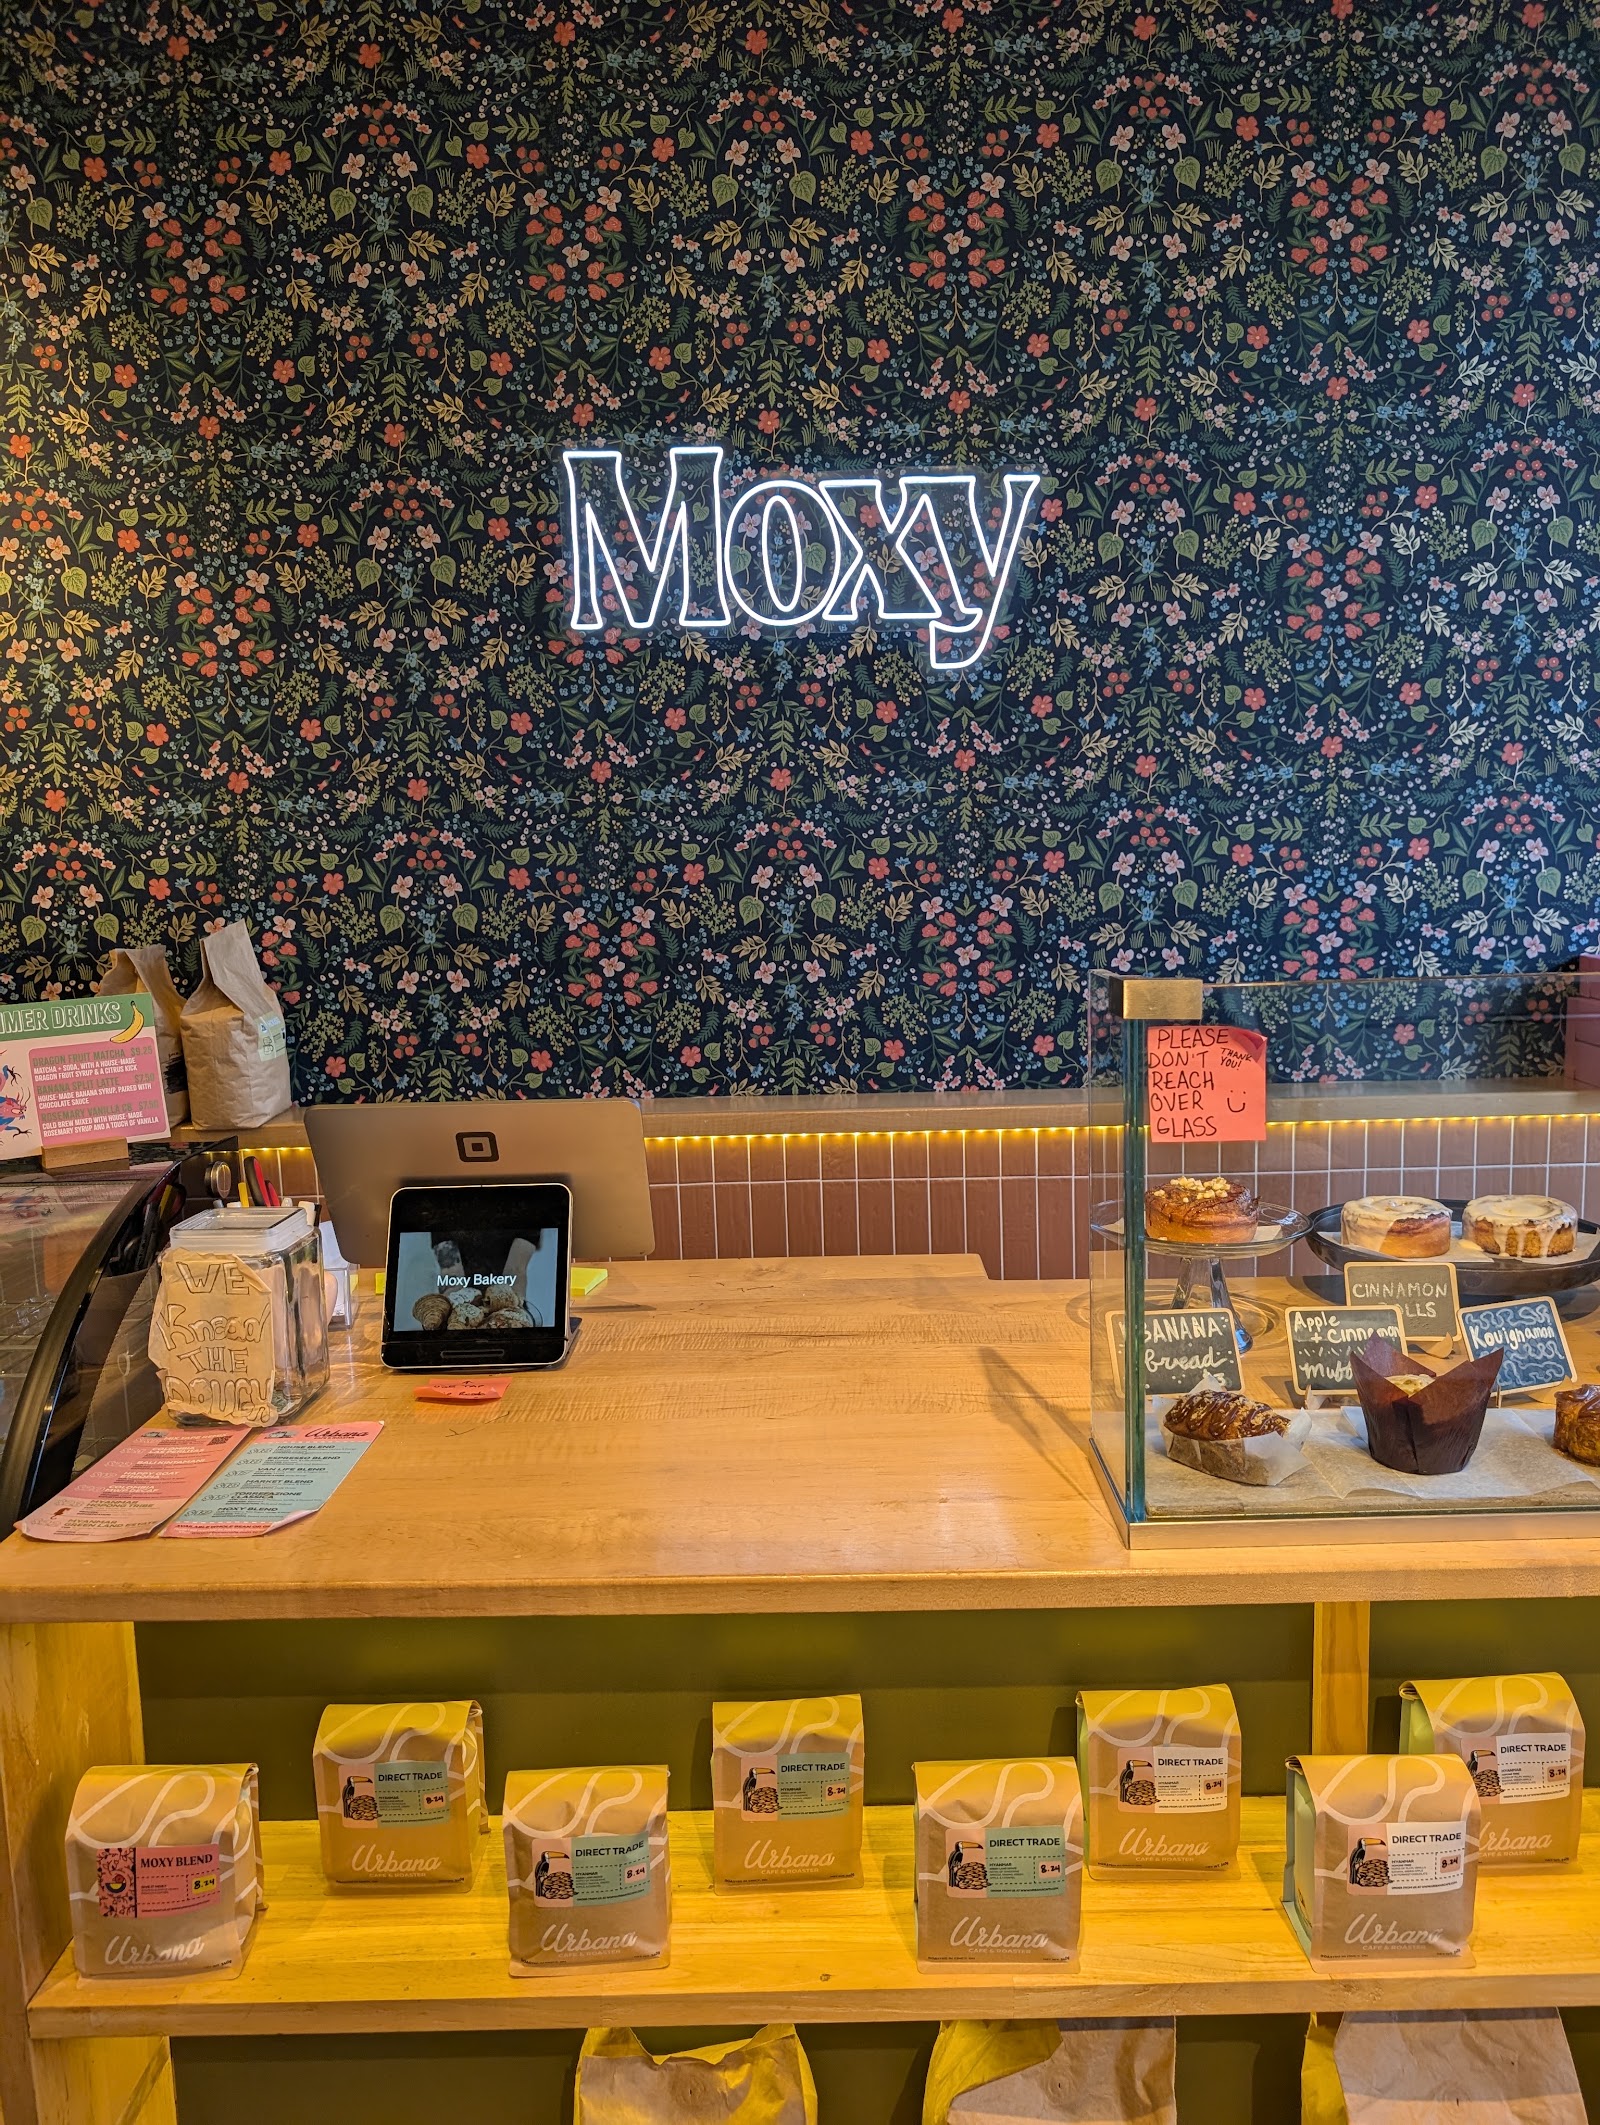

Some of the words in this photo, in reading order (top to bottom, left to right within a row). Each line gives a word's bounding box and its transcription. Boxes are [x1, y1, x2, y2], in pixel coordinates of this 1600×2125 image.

[562, 446, 1040, 670] Moxy
[51, 1001, 121, 1029] DRINKS
[1158, 1028, 1229, 1049] PLEASE
[33, 1056, 65, 1066] DRAGON
[68, 1053, 90, 1062] FRUIT
[94, 1049, 125, 1059] MATCHA
[1149, 1050, 1208, 1068] DON'T
[1221, 1048, 1252, 1061] THANK
[34, 1065, 57, 1075] MATCHA
[81, 1061, 94, 1070] WITH
[1221, 1057, 1242, 1070] YOU!
[35, 1072, 57, 1082] DRAGON
[76, 1069, 93, 1077] SYRUP
[105, 1066, 124, 1074] CITRUS
[1152, 1071, 1214, 1090] REACH
[37, 1083, 70, 1094] BANANA
[73, 1080, 94, 1090] SPLIT
[97, 1077, 119, 1087] LATTE
[76, 1089, 98, 1099] BANANA
[118, 1084, 137, 1093] PAIRED
[39, 1100, 71, 1109] CHOCOLATE
[72, 1098, 89, 1106] SAUCE
[1151, 1090, 1203, 1111] OVER
[41, 1110, 85, 1121] ROSEMARY
[88, 1104, 120, 1116] VANILLA
[42, 1122, 56, 1130] COLD
[75, 1117, 92, 1125] MIXED
[44, 1128, 73, 1137] ROSEMARY
[75, 1125, 93, 1133] SYRUP
[111, 1120, 129, 1128] TOUCH
[137, 1117, 159, 1125] VANILLA
[1157, 1116, 1217, 1138] GLASS
[176, 1261, 250, 1295] WE
[437, 1275, 470, 1287] Moxy
[473, 1273, 517, 1287] Bakery
[1352, 1283, 1448, 1298] CINNAMON
[1295, 1312, 1340, 1332] Apple
[177, 1346, 249, 1374] THE
[1500, 1745, 1533, 1754] DIRECT
[1535, 1743, 1567, 1752] TRADE
[781, 1764, 813, 1773] DIRECT
[815, 1763, 846, 1771] TRADE
[1158, 1758, 1191, 1766] DIRECT
[1193, 1757, 1224, 1765] TRADE
[378, 1773, 411, 1782] DIRECT
[414, 1772, 443, 1780] TRADE
[989, 1839, 1025, 1848] DIRECT
[1027, 1838, 1060, 1846] TRADE
[1119, 1828, 1210, 1856] Urbana
[1392, 1835, 1428, 1844] DIRECT
[1430, 1832, 1461, 1842] TRADE
[575, 1847, 611, 1857] DIRECT
[613, 1840, 644, 1855] TRADE
[744, 1840, 835, 1869] Urbana
[140, 1856, 174, 1869] MOXY
[176, 1854, 213, 1866] BLEND
[352, 1844, 441, 1872] Urbana
[540, 1923, 638, 1952] Urbana
[950, 1916, 1049, 1948] Urbana
[1344, 1913, 1444, 1945] Urbana
[105, 1935, 205, 1965] Urbana
